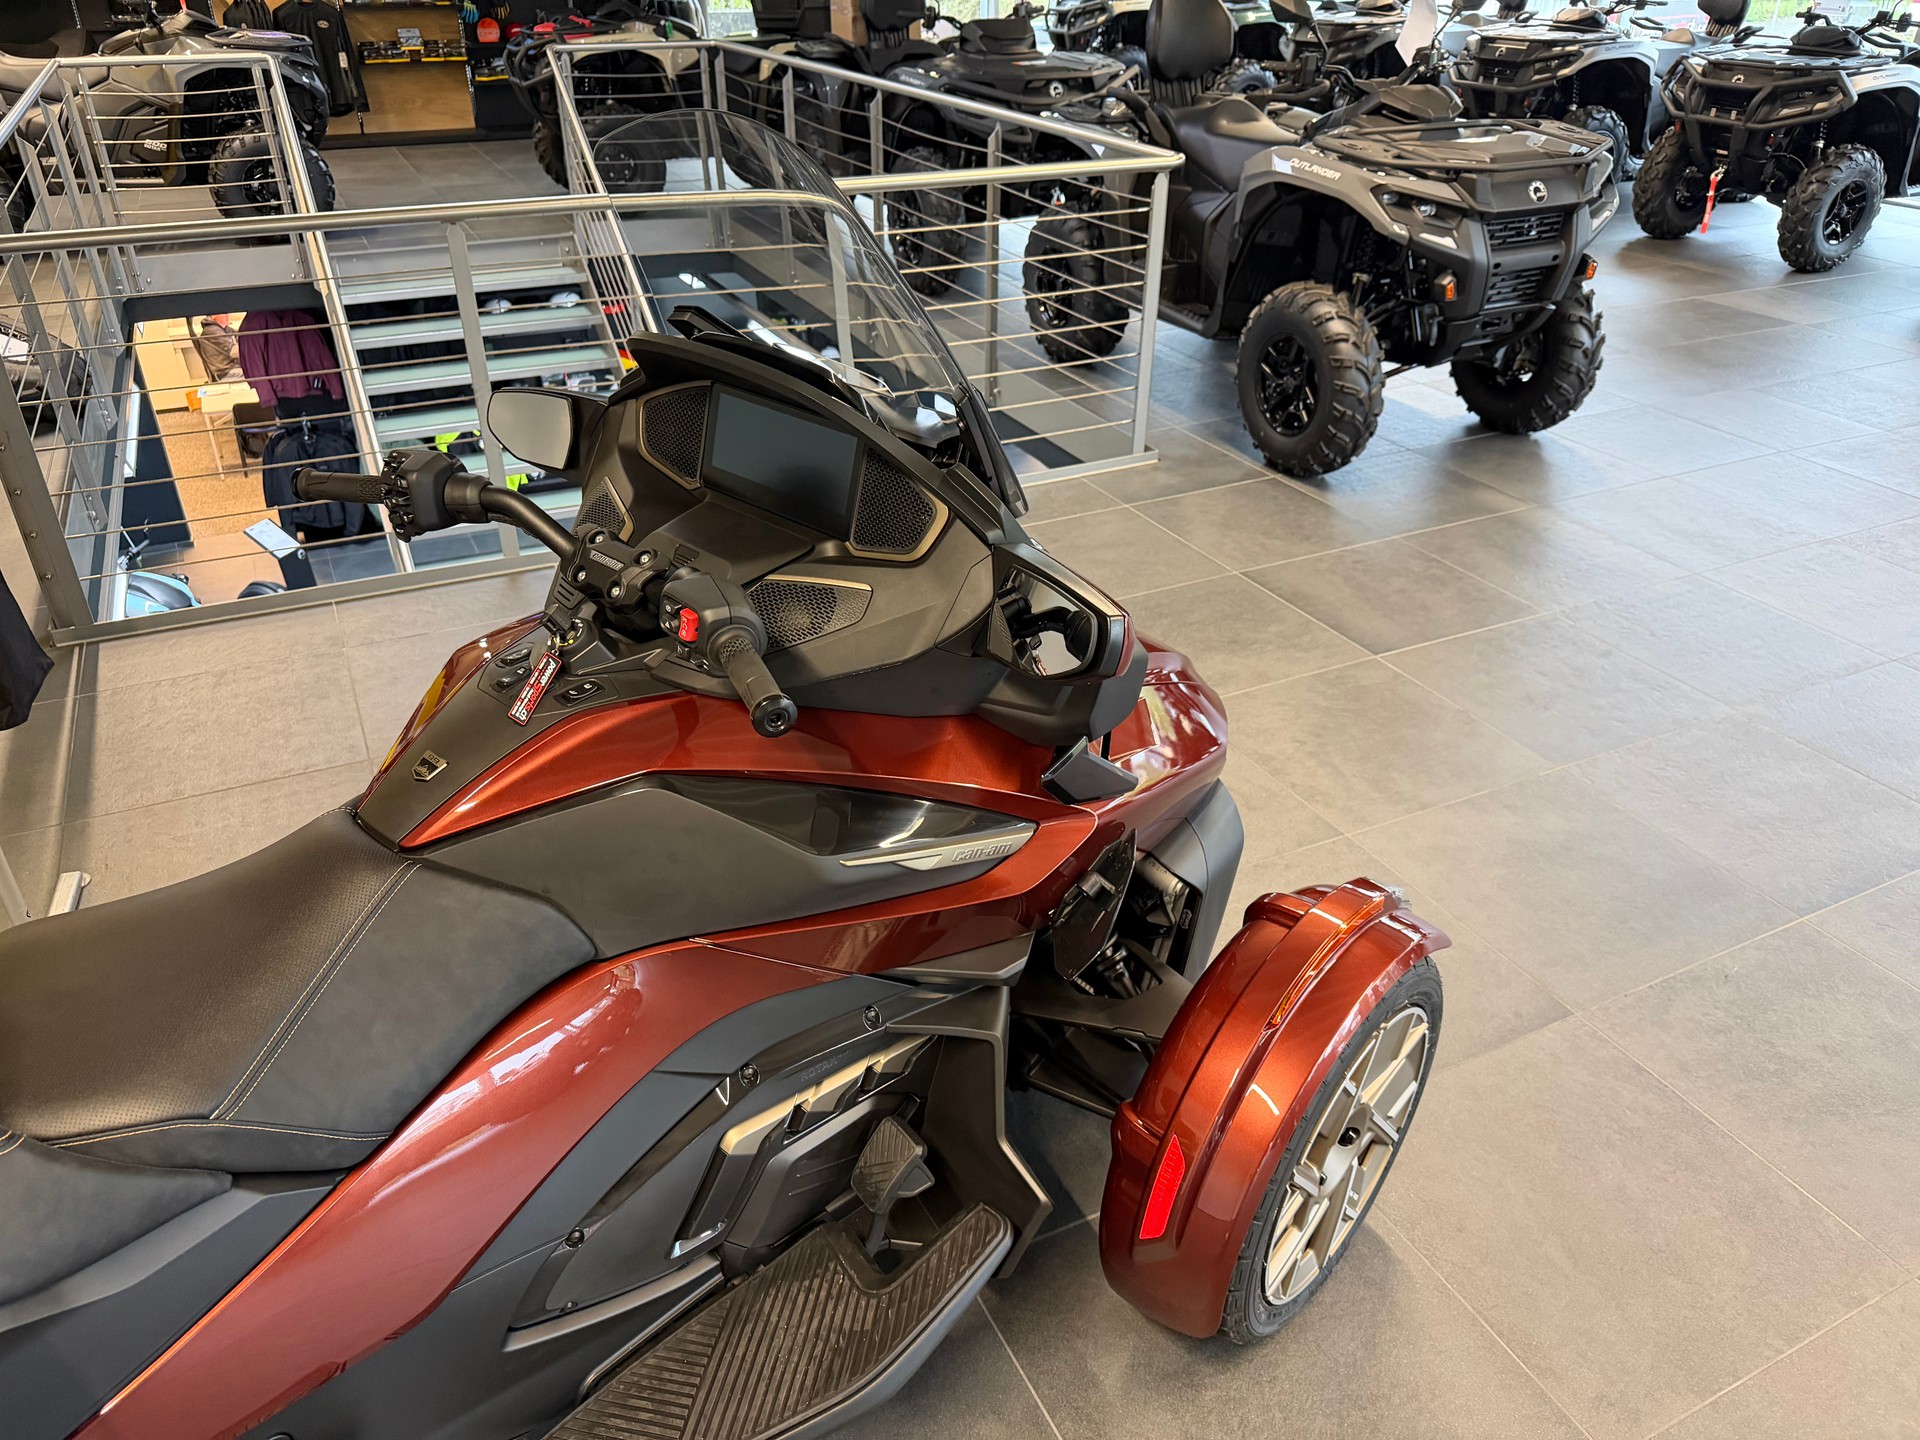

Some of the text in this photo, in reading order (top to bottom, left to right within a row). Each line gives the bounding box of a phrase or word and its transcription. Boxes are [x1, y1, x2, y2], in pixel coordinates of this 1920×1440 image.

[1289, 157, 1342, 181] OUTLANDER
[518, 658, 557, 721] powersports.ch
[952, 842, 1012, 862] can-am
[800, 1055, 838, 1082] ROTAX
